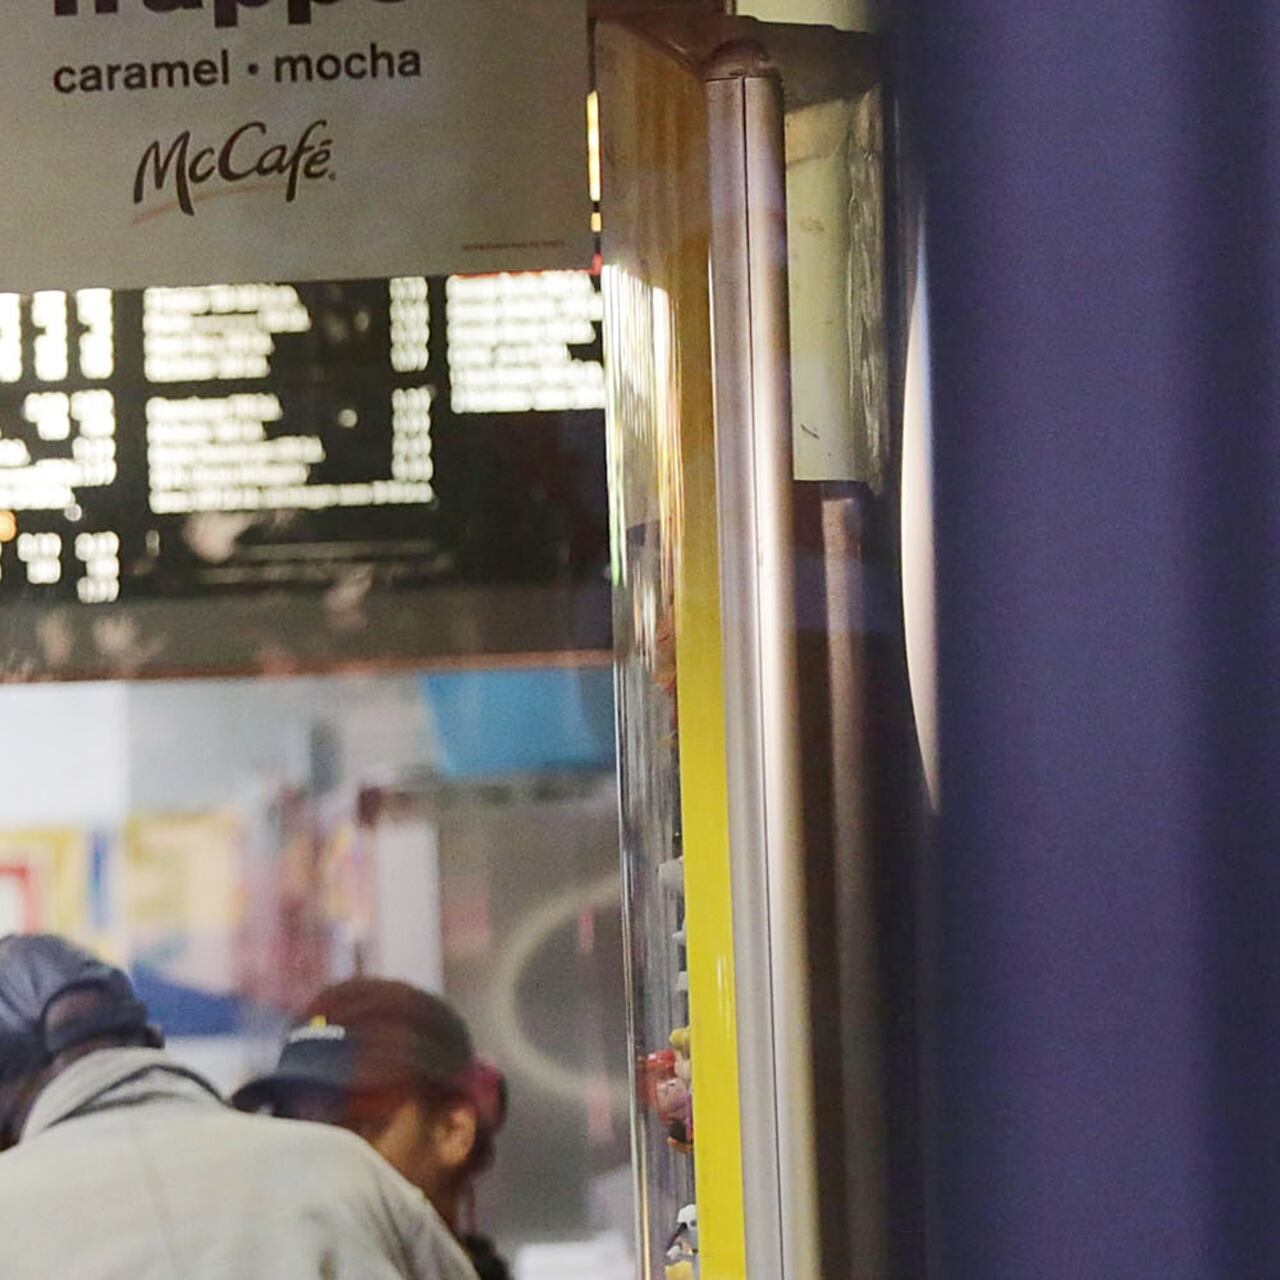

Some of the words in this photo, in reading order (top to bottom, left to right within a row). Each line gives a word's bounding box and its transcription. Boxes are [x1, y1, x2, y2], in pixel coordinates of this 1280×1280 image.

[54, 49, 230, 93] caramel
[274, 42, 422, 83] mocha
[133, 119, 334, 216] McCafé
